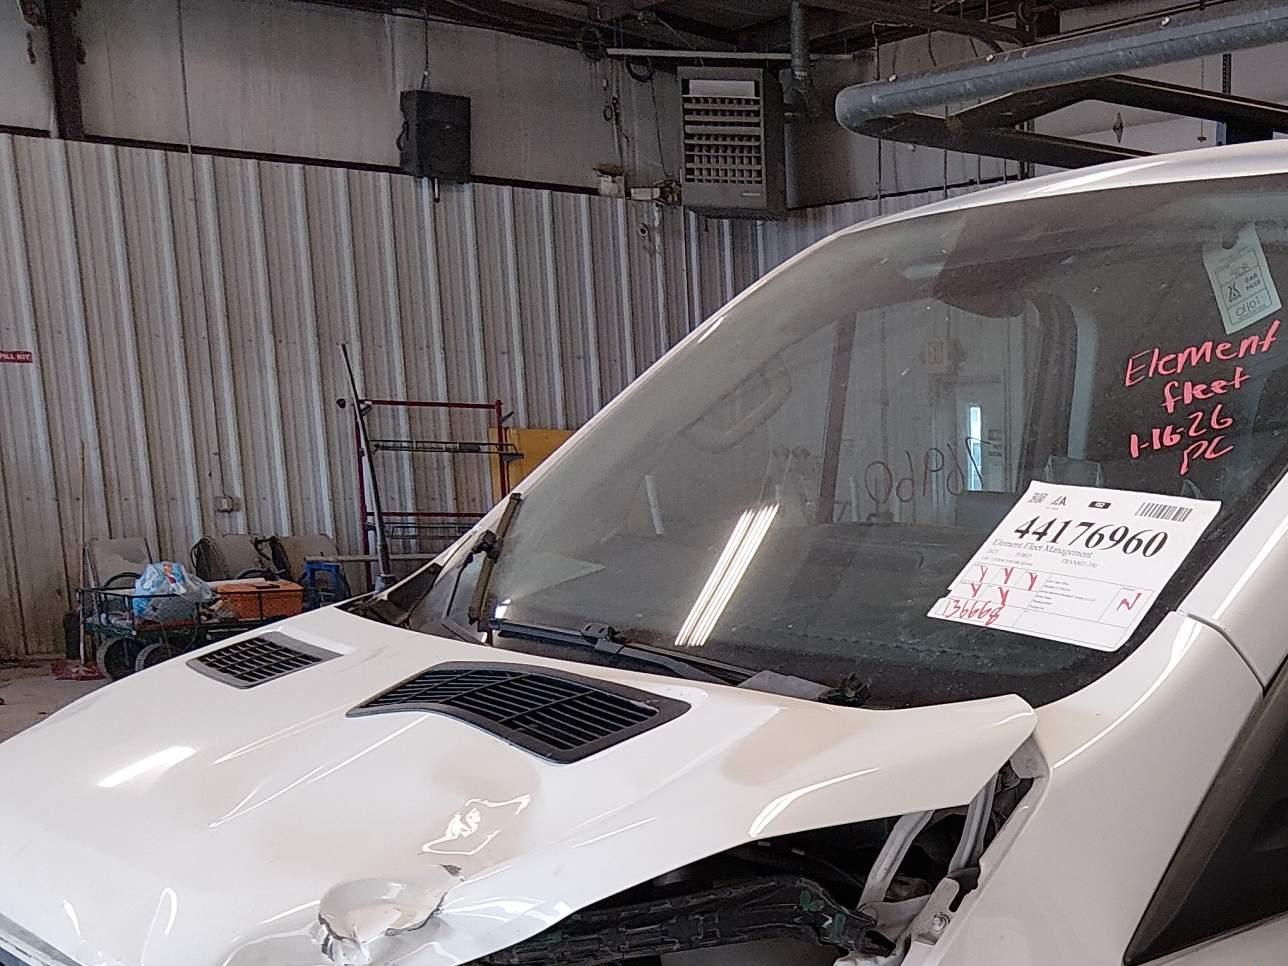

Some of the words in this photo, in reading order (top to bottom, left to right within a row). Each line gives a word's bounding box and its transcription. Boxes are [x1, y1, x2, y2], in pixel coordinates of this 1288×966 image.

[1125, 319, 1281, 387] Element
[1129, 404, 1234, 459] 1-16-26
[991, 539, 1023, 548] Element
[1023, 542, 1043, 552] Fleet
[1043, 545, 1093, 558] Management
[1014, 514, 1169, 558] 44176960
